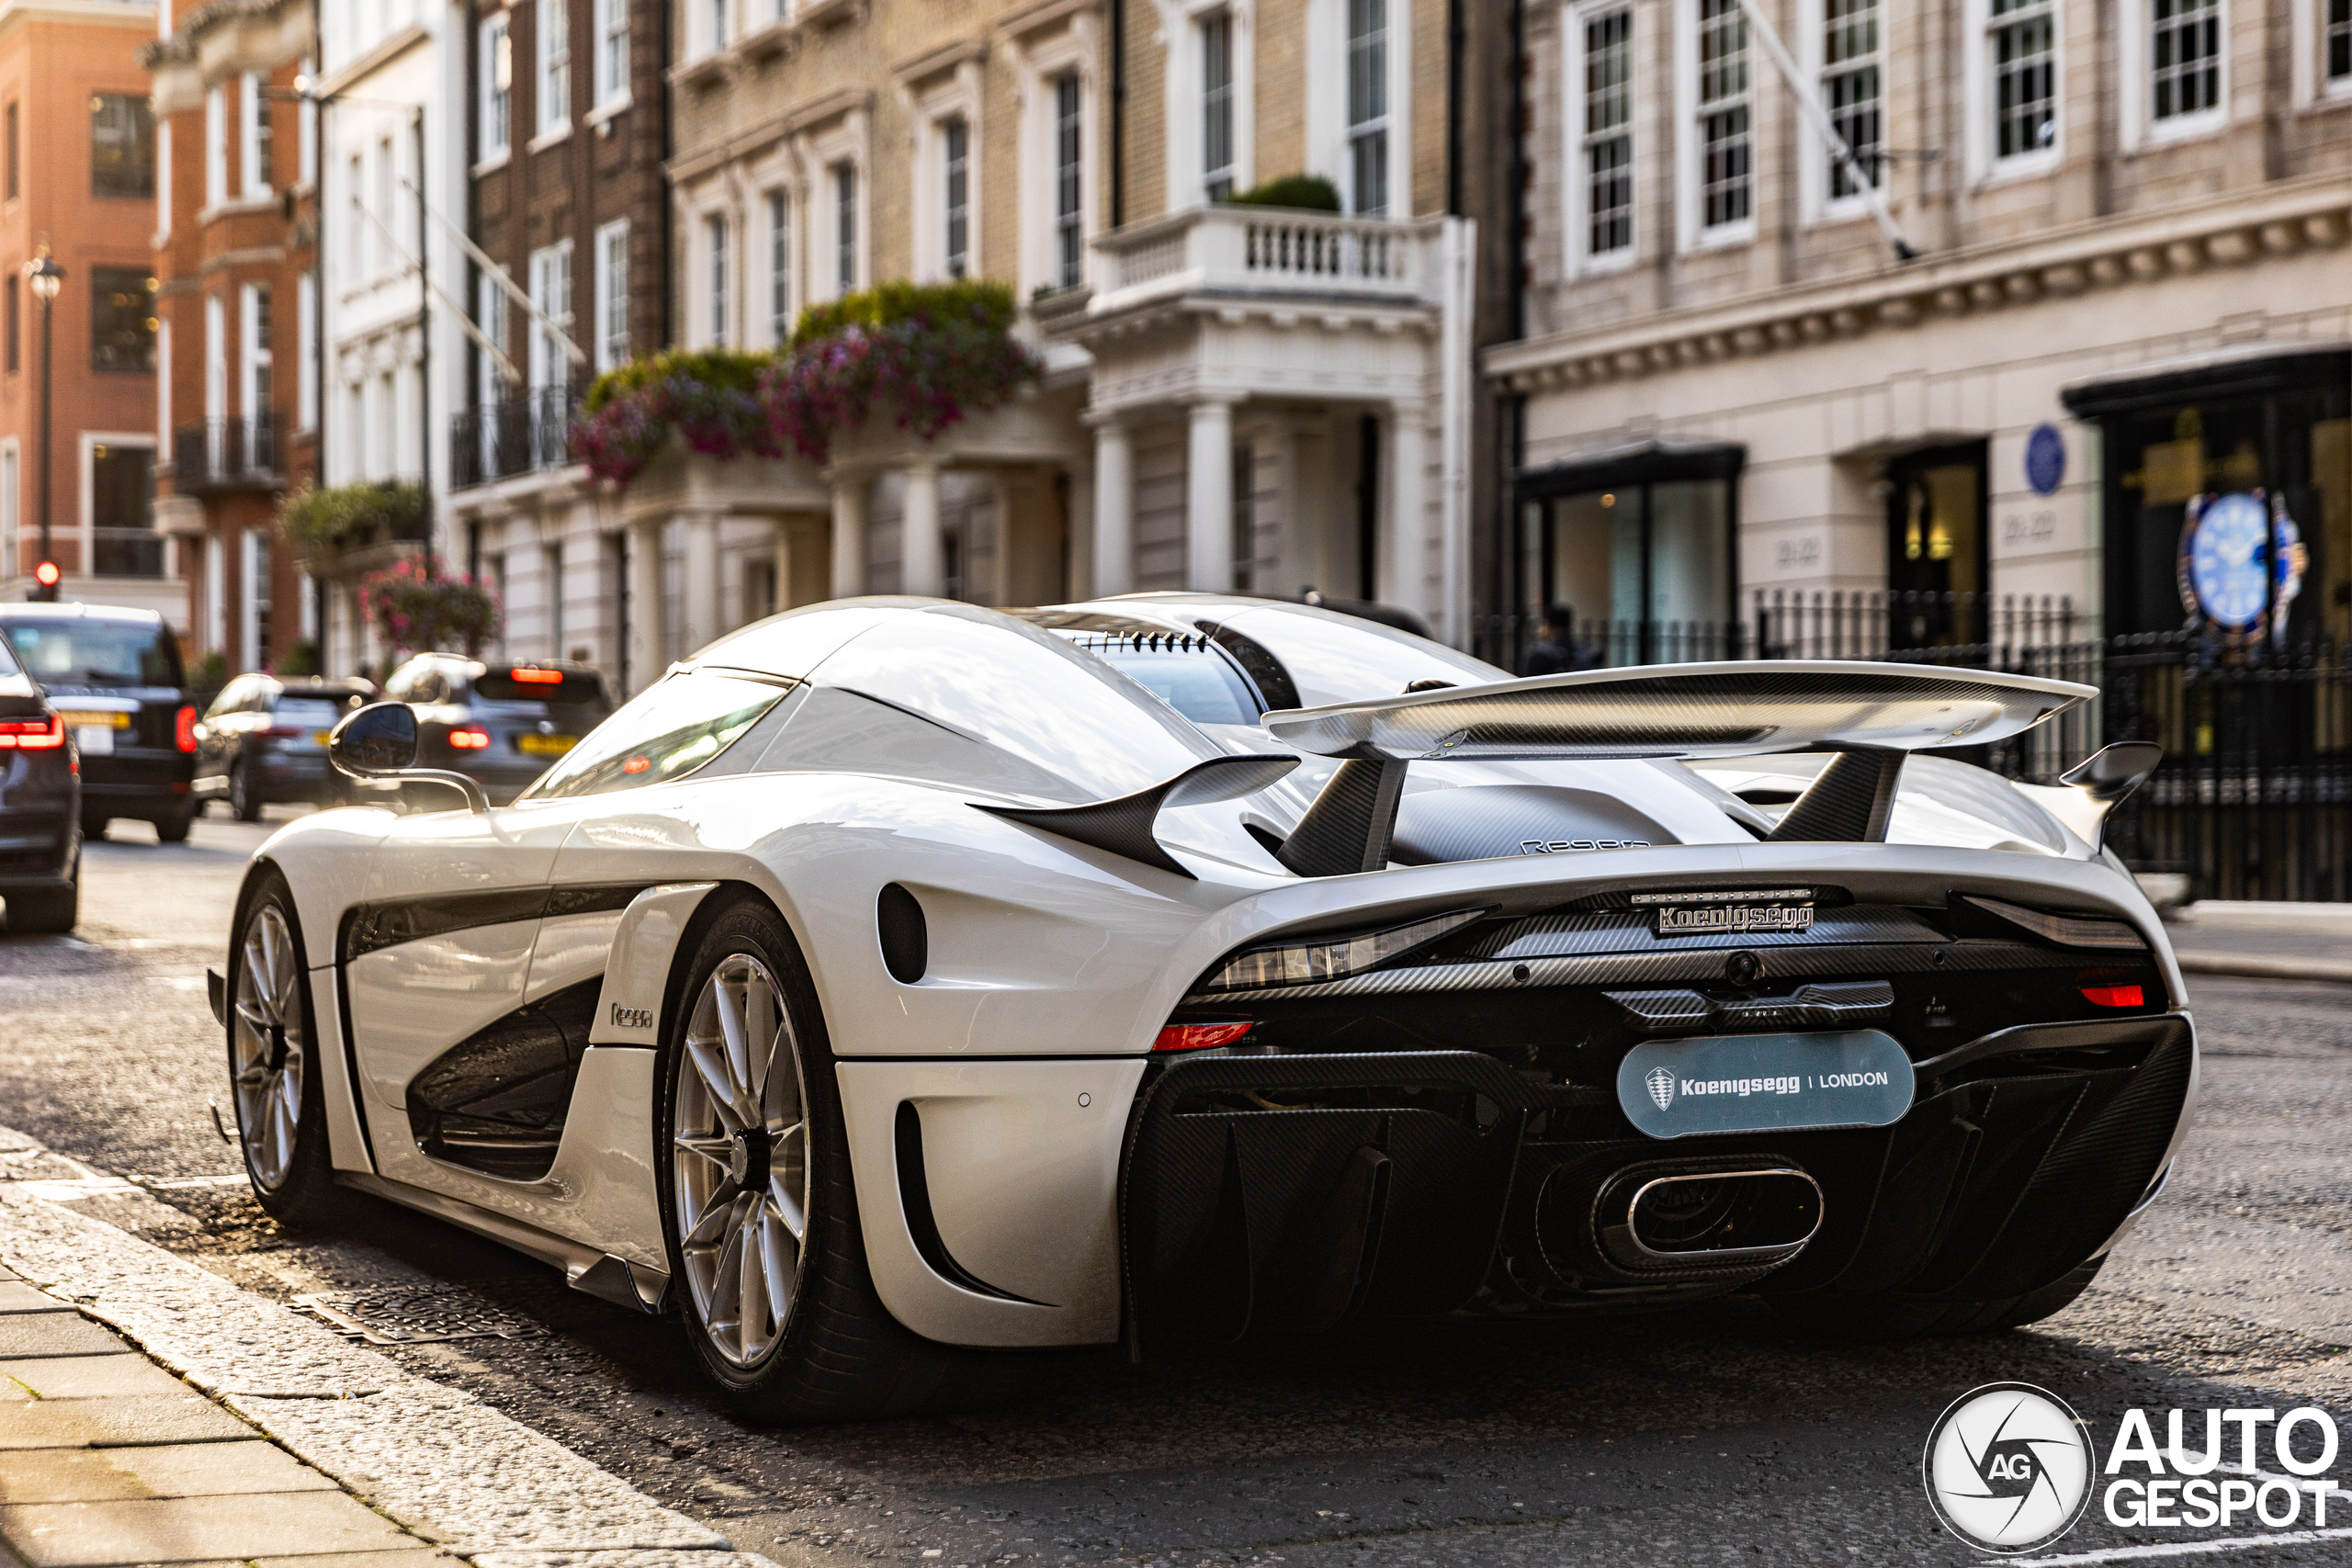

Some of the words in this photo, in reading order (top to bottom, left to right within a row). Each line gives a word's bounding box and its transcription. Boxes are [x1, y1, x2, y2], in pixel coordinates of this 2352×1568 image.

[1659, 905, 1814, 933] Koenigsegg
[1681, 1077, 1800, 1097] Koenigsegg
[1820, 1071, 1888, 1089] LONDON
